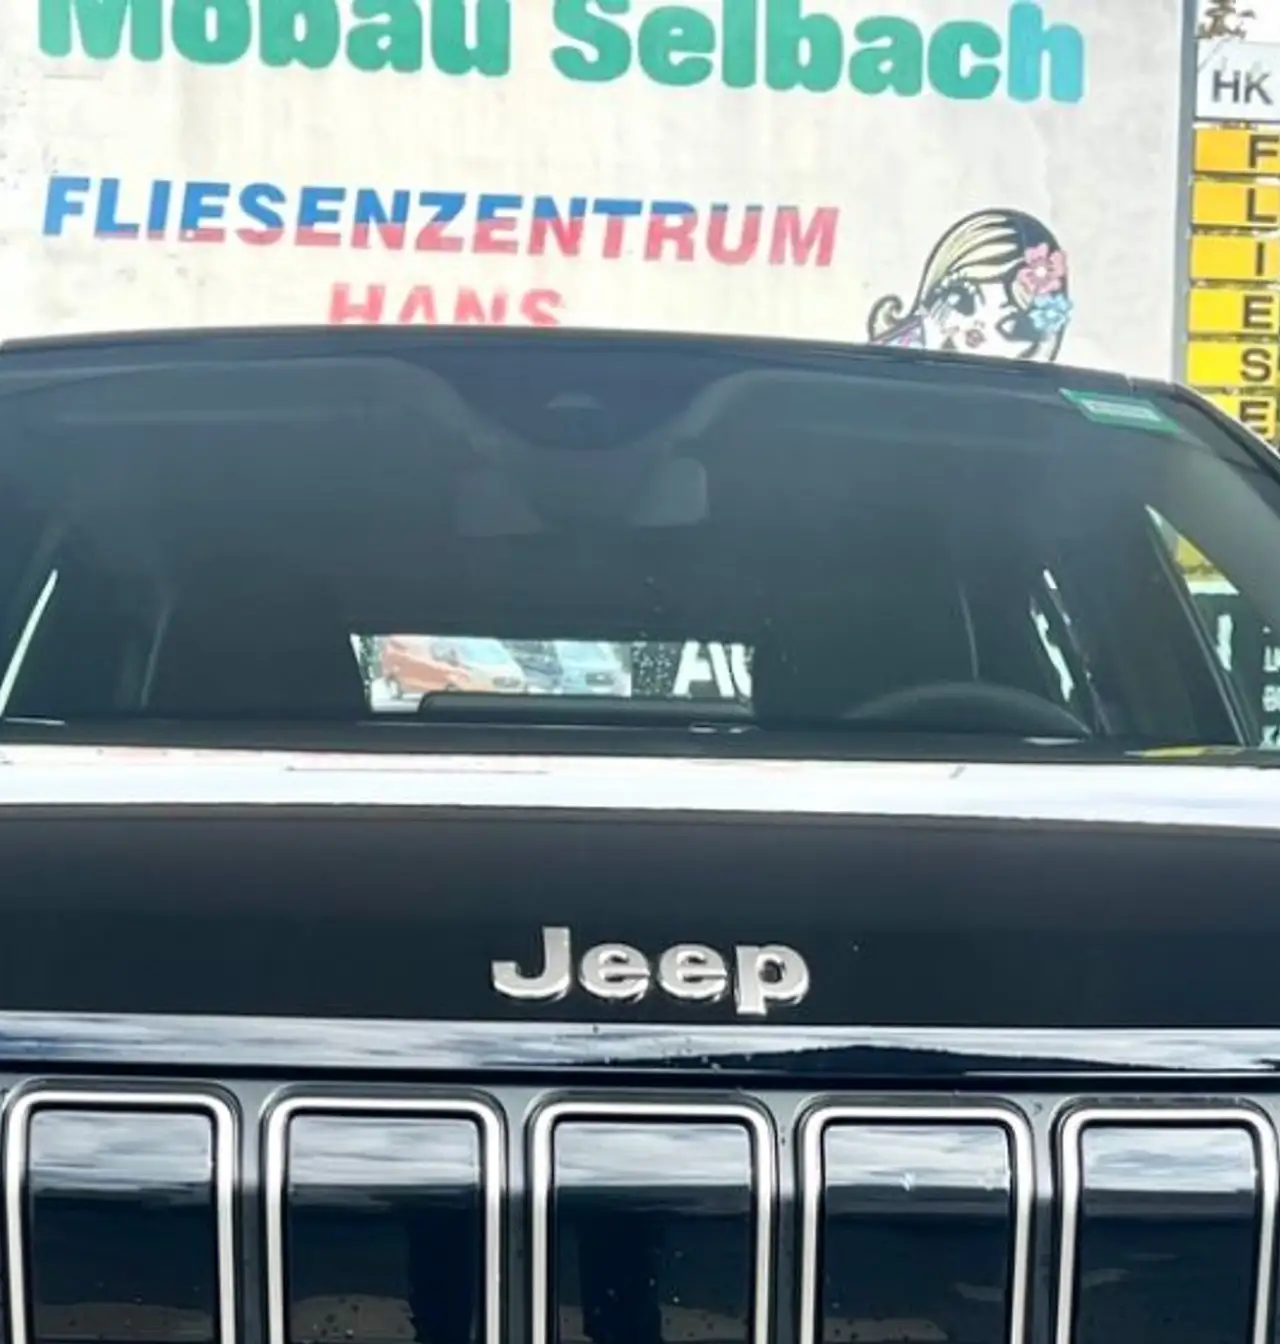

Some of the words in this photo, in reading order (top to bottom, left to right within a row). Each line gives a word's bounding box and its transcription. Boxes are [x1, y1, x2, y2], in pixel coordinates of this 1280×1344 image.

[37, 0, 511, 78] Mobau
[551, 0, 1086, 104] Selbach
[1212, 74, 1274, 107] HK
[41, 175, 840, 269] FLIESENZENTRUM
[327, 282, 565, 327] HANS
[492, 926, 812, 1017] Jeep
